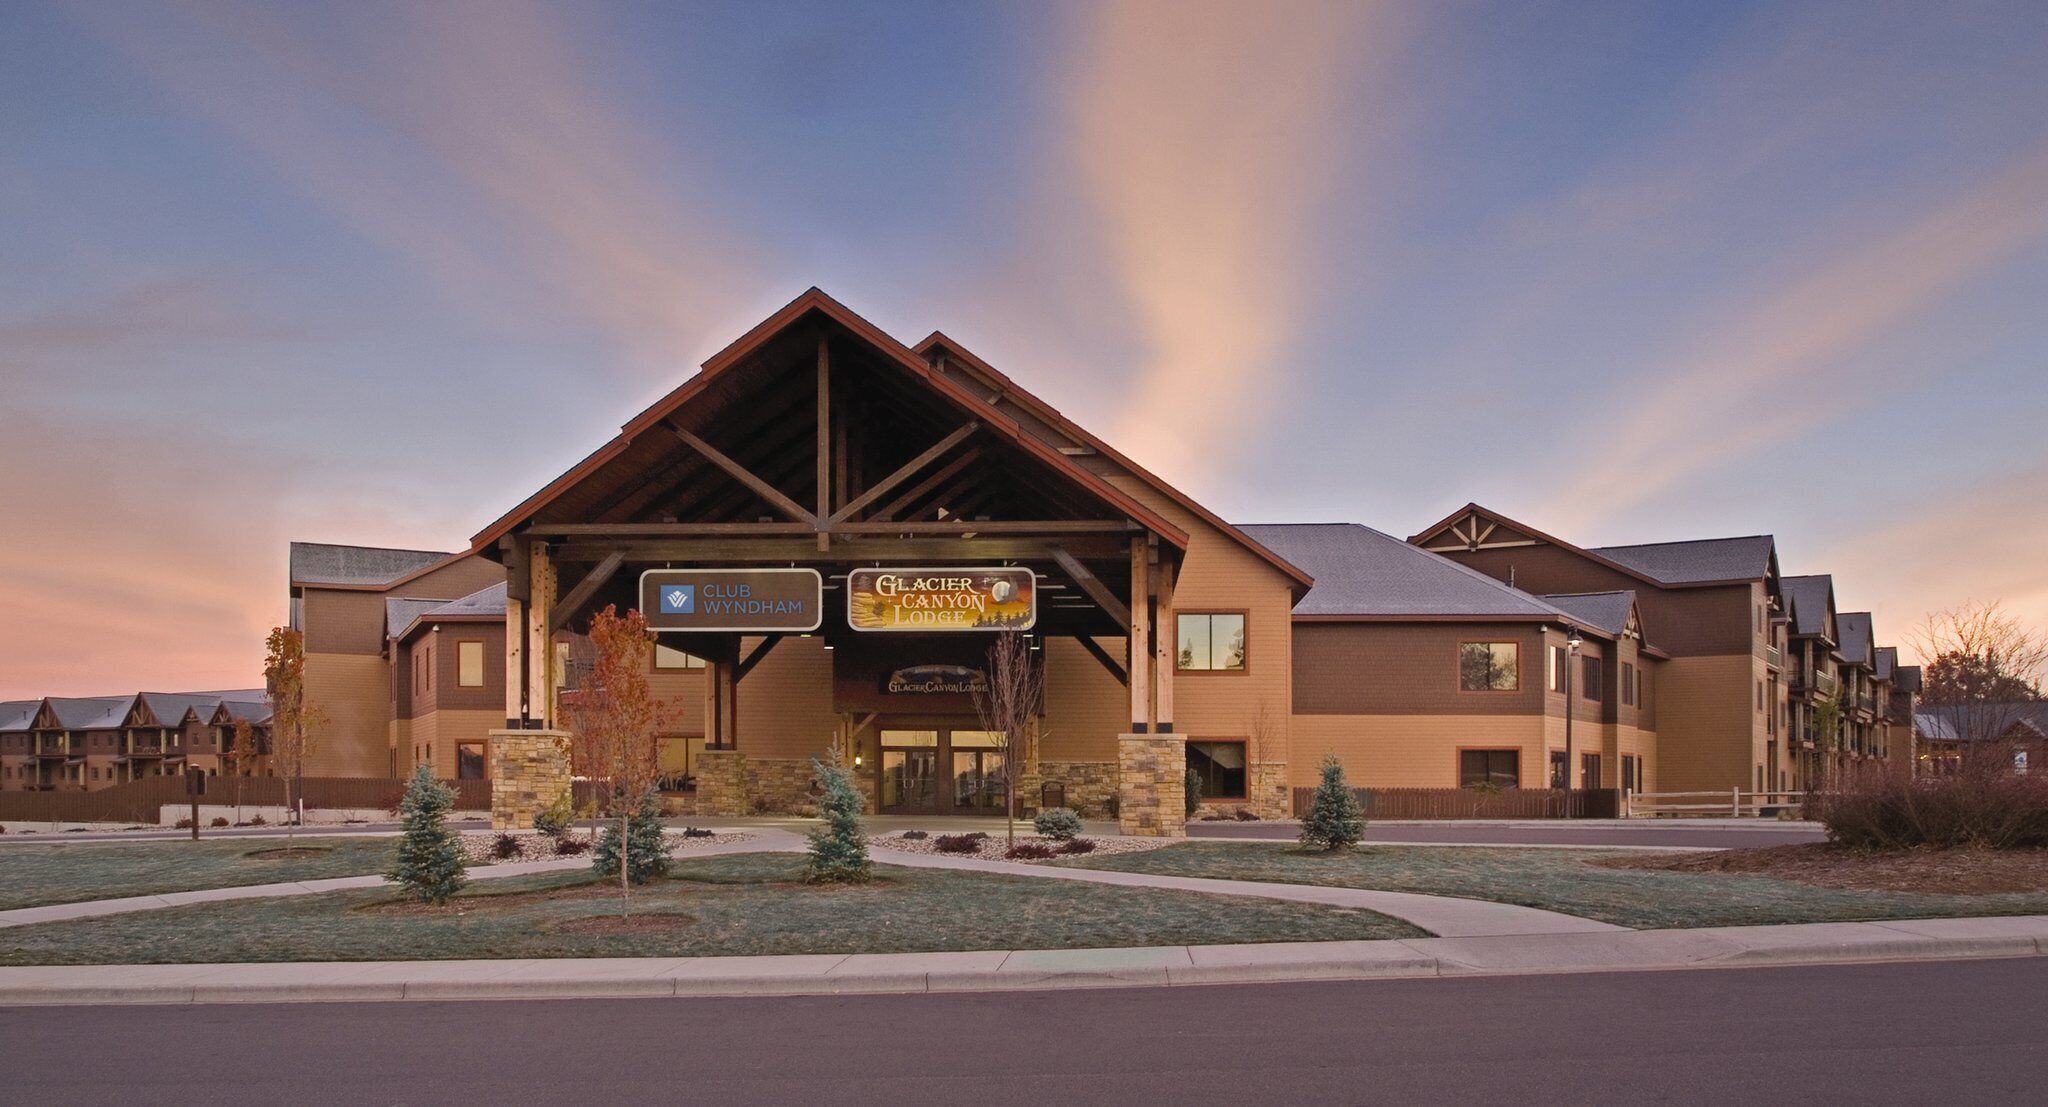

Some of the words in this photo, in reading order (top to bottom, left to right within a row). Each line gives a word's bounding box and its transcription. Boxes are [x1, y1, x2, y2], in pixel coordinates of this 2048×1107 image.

[703, 584, 751, 598] CLUB
[875, 574, 981, 597] GLACIER
[703, 601, 803, 614] WYNDHAM
[902, 591, 987, 613] CANYON
[893, 604, 966, 625] LODGE
